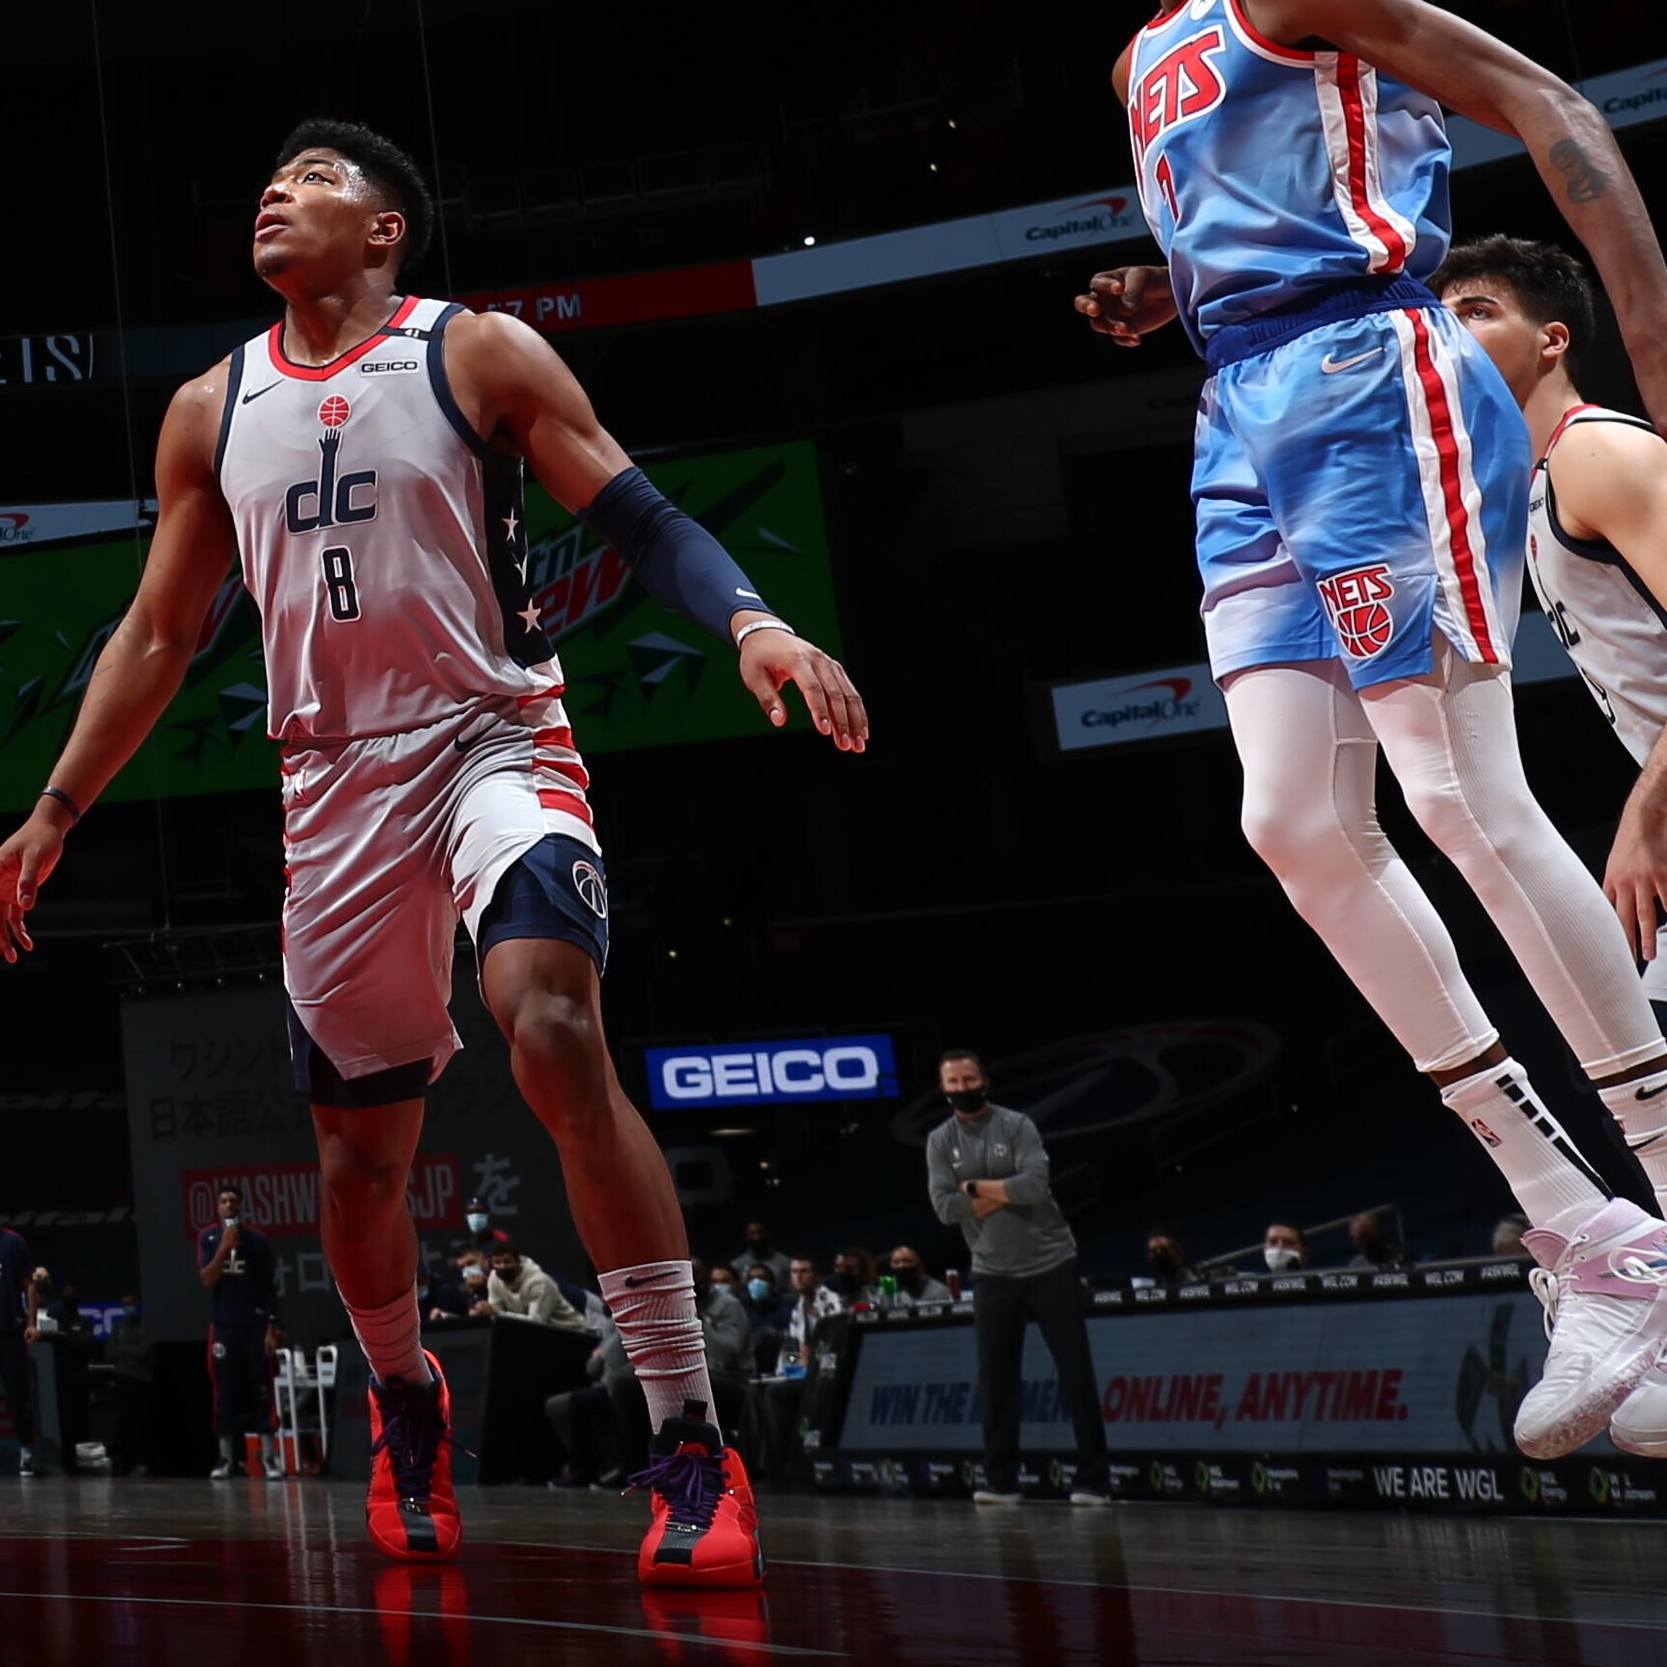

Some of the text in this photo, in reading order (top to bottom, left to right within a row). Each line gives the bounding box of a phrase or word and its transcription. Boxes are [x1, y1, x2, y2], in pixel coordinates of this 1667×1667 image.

[535, 293, 583, 322] PM
[360, 360, 418, 373] GEICO
[285, 428, 378, 534] dc
[322, 546, 360, 621] 8
[1318, 565, 1393, 622] NETS
[661, 1045, 880, 1100] GEICO
[473, 1153, 521, 1215] を
[870, 1383, 921, 1425] WIN
[923, 1382, 971, 1424] THE
[1103, 1374, 1228, 1431] ONLINE,
[1236, 1370, 1411, 1422] ANYTIME.
[1373, 1465, 1406, 1496] WE
[1411, 1466, 1451, 1498] ARE
[1454, 1468, 1505, 1501] WGL
